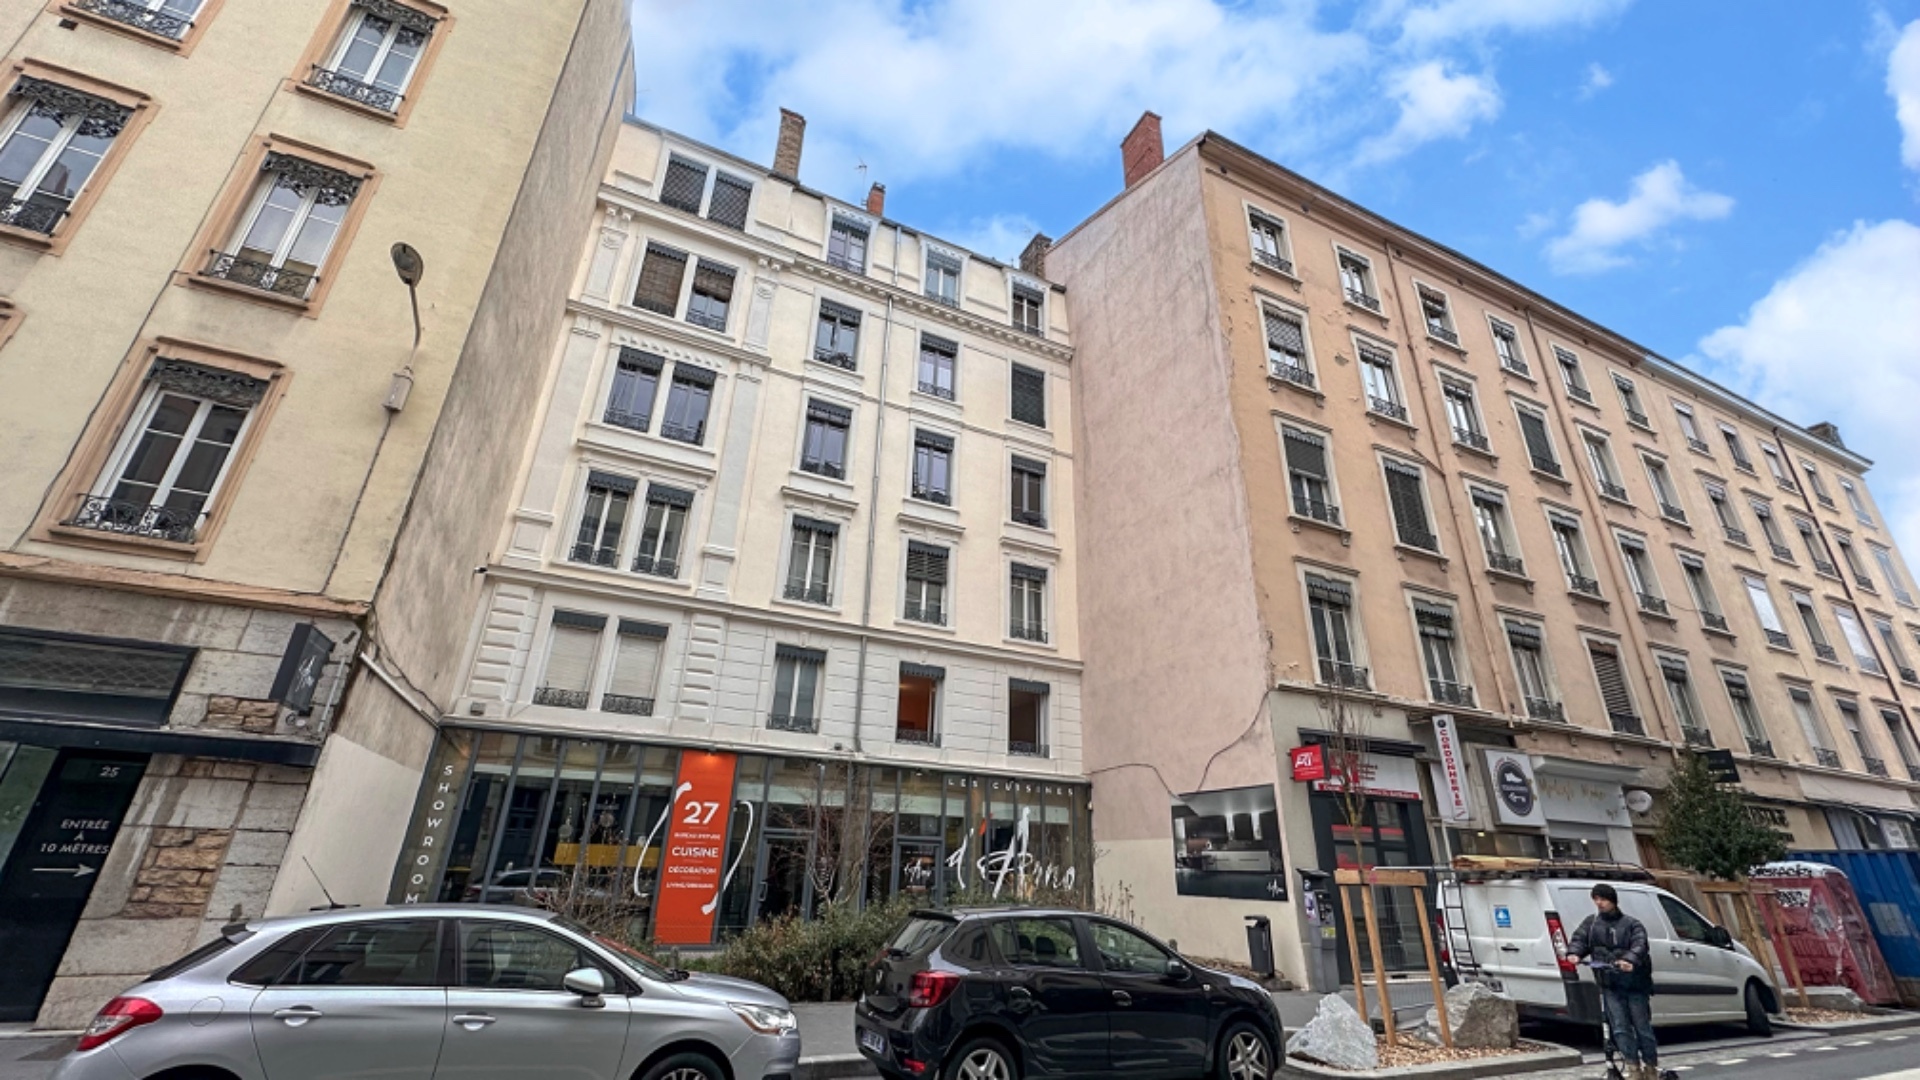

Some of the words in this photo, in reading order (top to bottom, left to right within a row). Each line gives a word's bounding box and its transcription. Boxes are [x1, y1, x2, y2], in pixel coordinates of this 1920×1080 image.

[100, 766, 120, 777] 25
[948, 778, 978, 788] LES
[992, 781, 1074, 796] CUISINES
[683, 801, 720, 825] 27
[60, 819, 111, 829] ENTRÉE
[405, 765, 453, 904] SHOWROOM
[40, 843, 57, 853] 10
[672, 846, 719, 858] CUISINE
